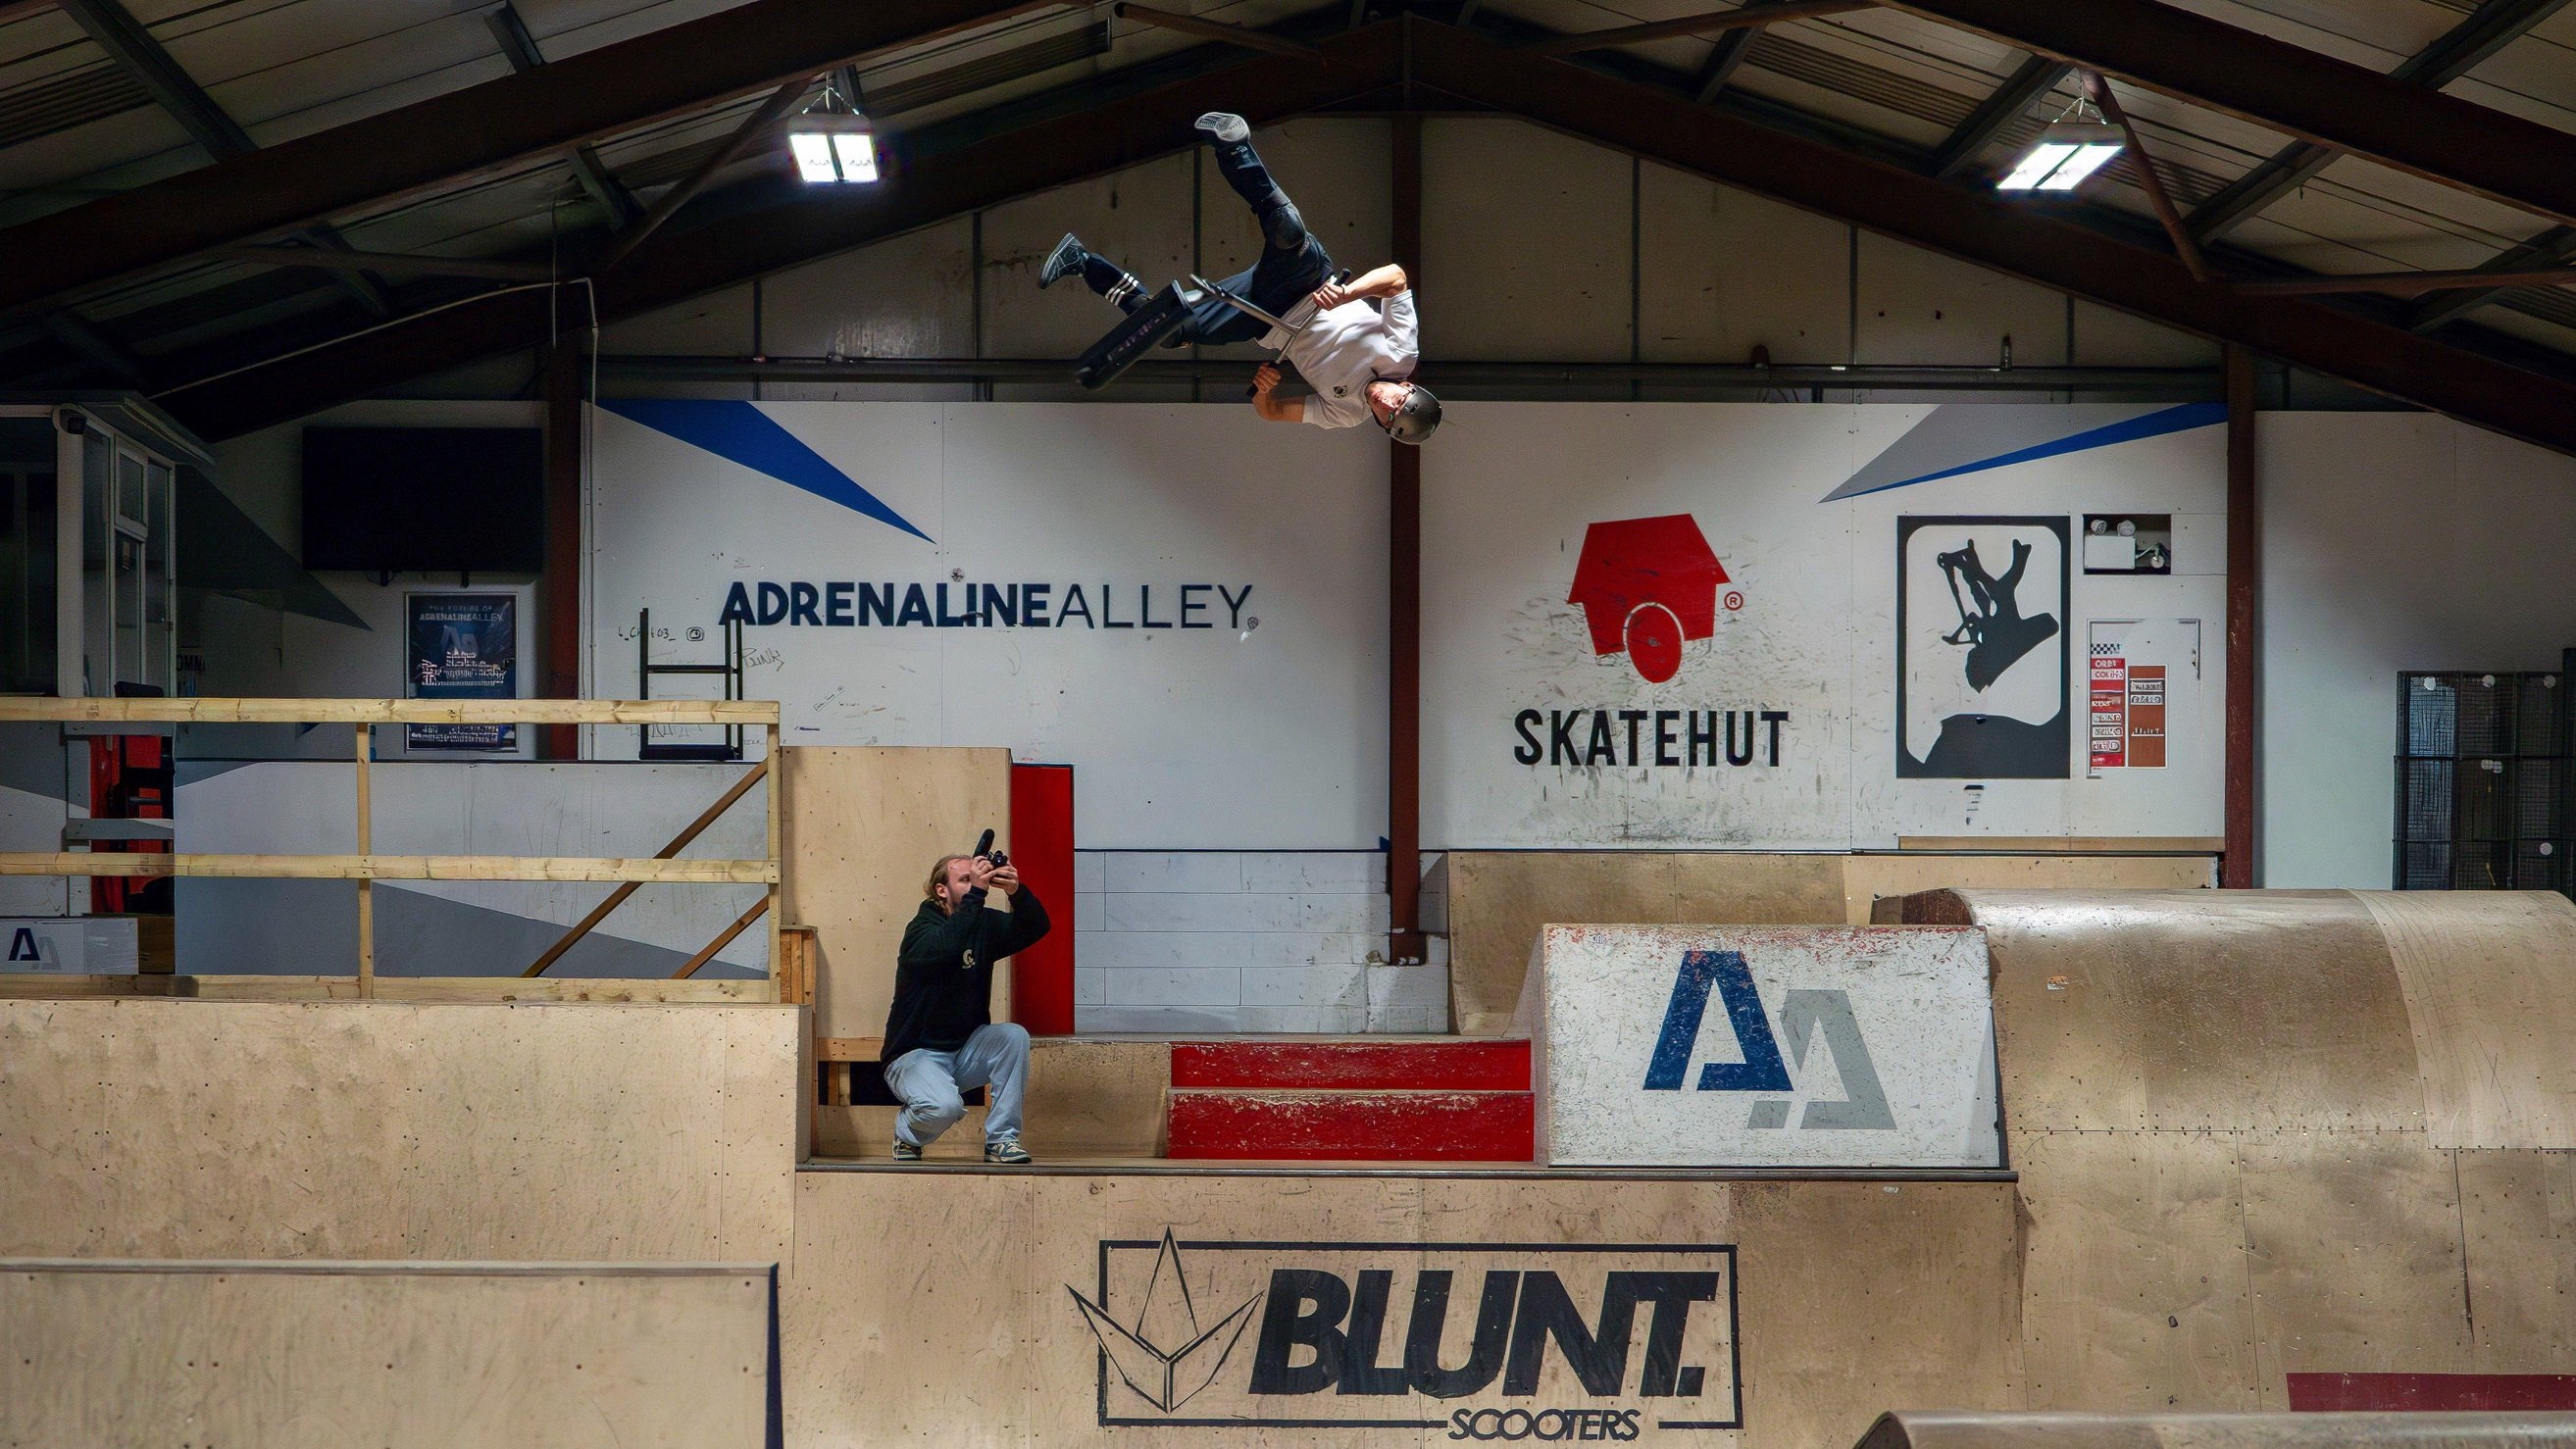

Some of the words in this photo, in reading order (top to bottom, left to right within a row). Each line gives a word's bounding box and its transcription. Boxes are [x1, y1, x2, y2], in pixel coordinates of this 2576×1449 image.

[718, 580, 1253, 629] ADRENALINEALLEY
[1513, 708, 1790, 768] SKATEHUT
[1447, 1407, 1642, 1442] SCOOTERS
